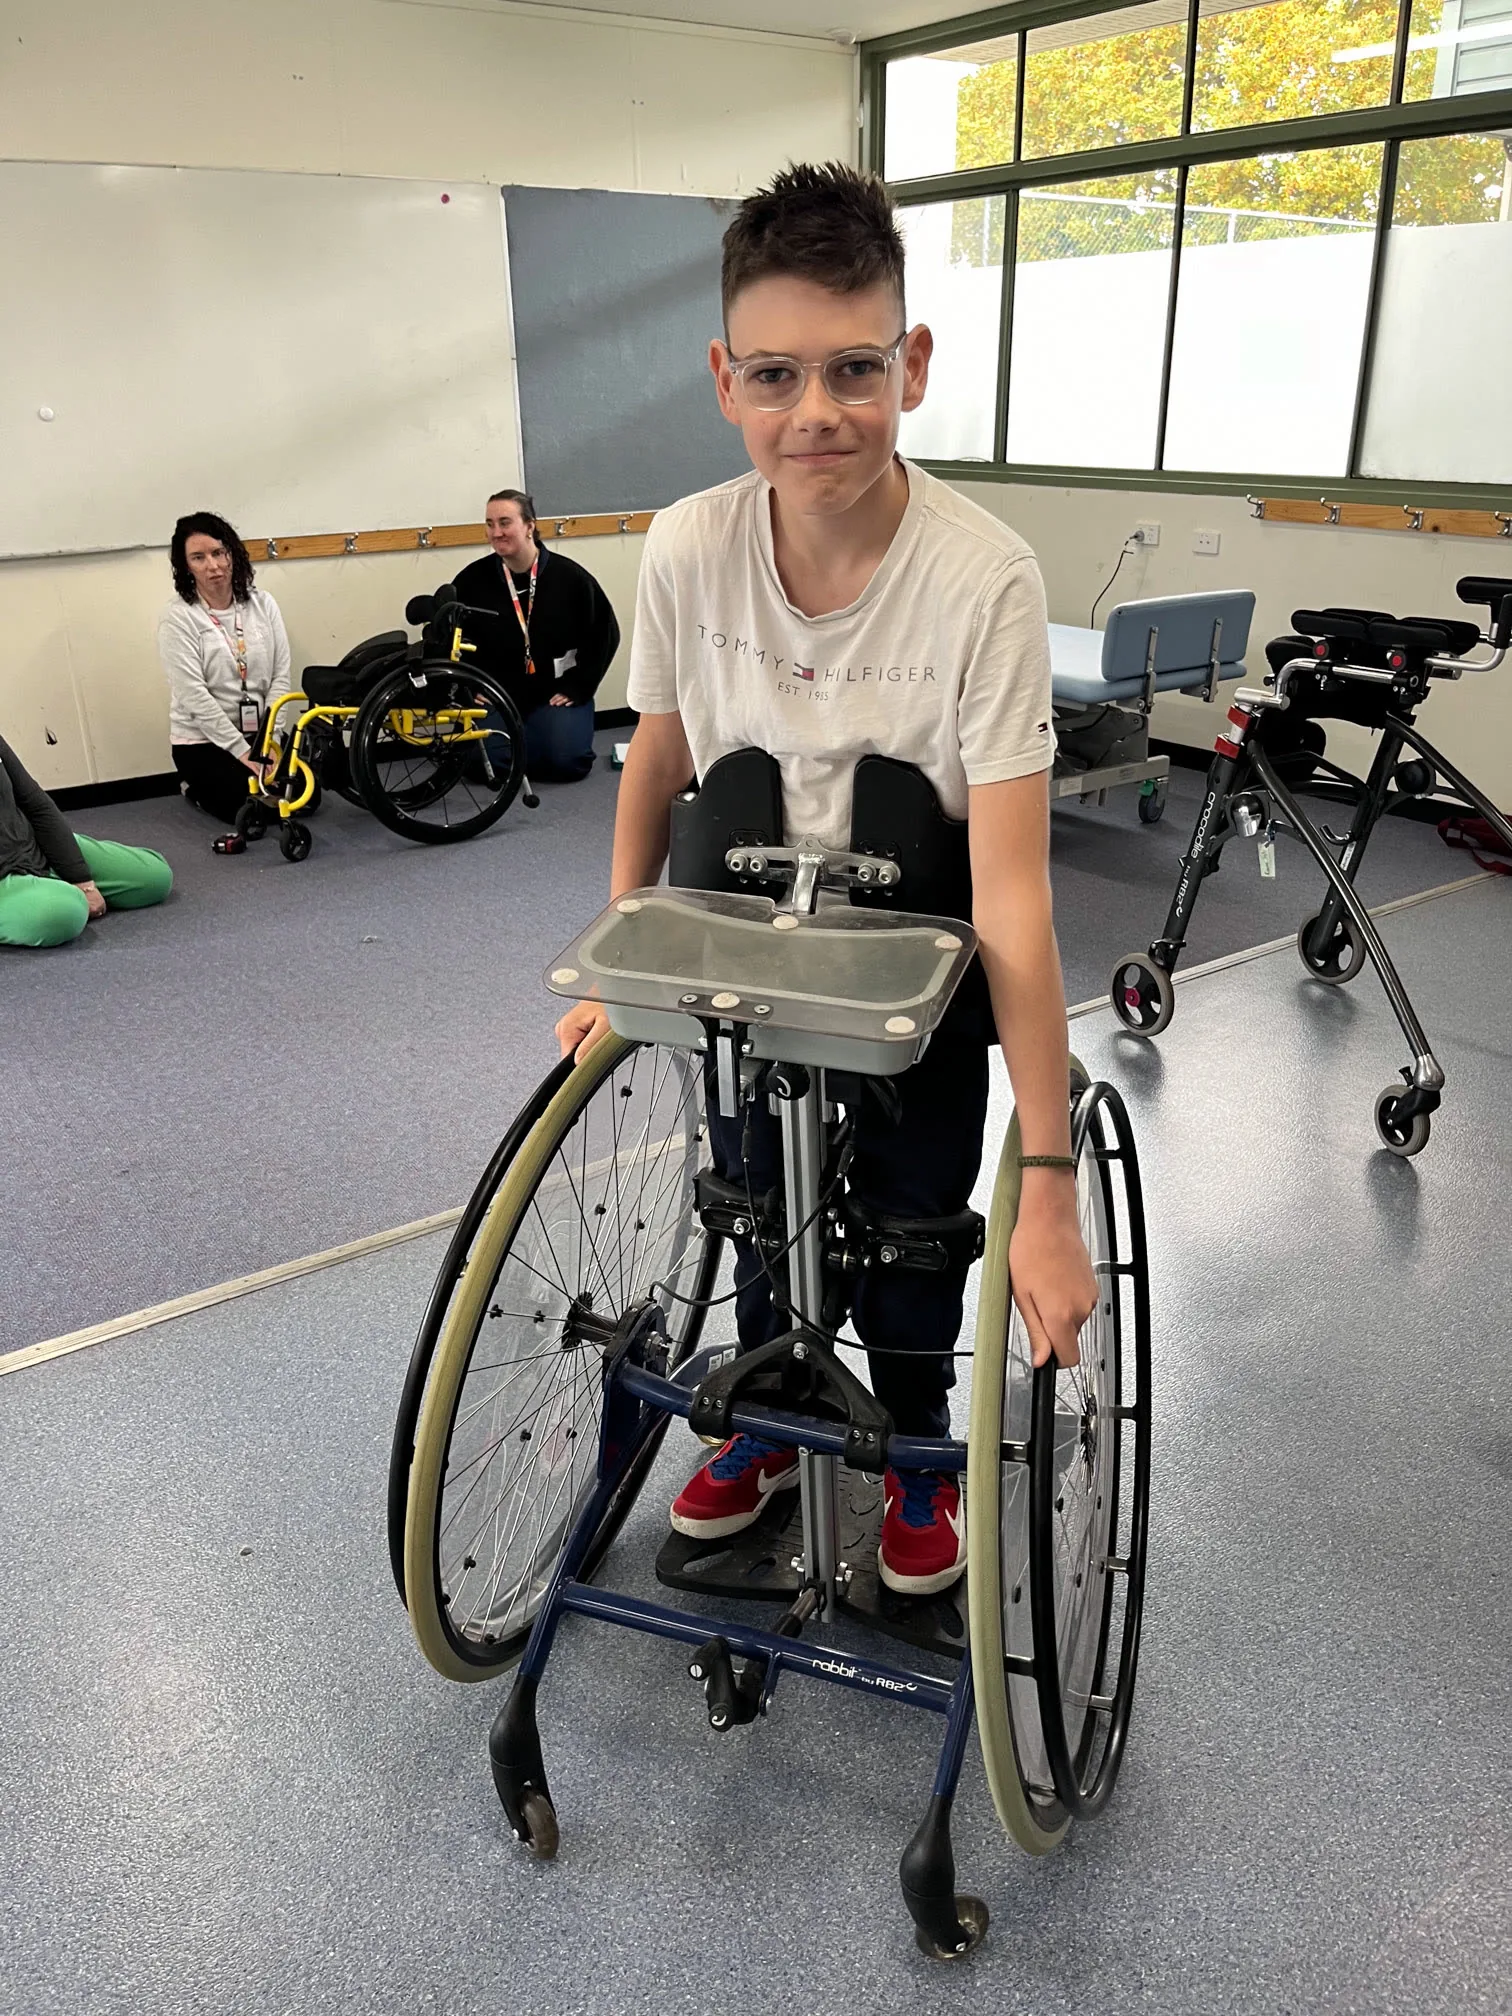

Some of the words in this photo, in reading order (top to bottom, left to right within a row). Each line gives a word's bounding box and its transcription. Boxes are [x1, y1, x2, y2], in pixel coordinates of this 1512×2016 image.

[697, 624, 784, 670] TOMMY
[823, 666, 937, 683] HILFIGER
[1190, 791, 1216, 859] crocodile
[812, 1659, 858, 1679] rabbit
[875, 1677, 905, 1692] R82
